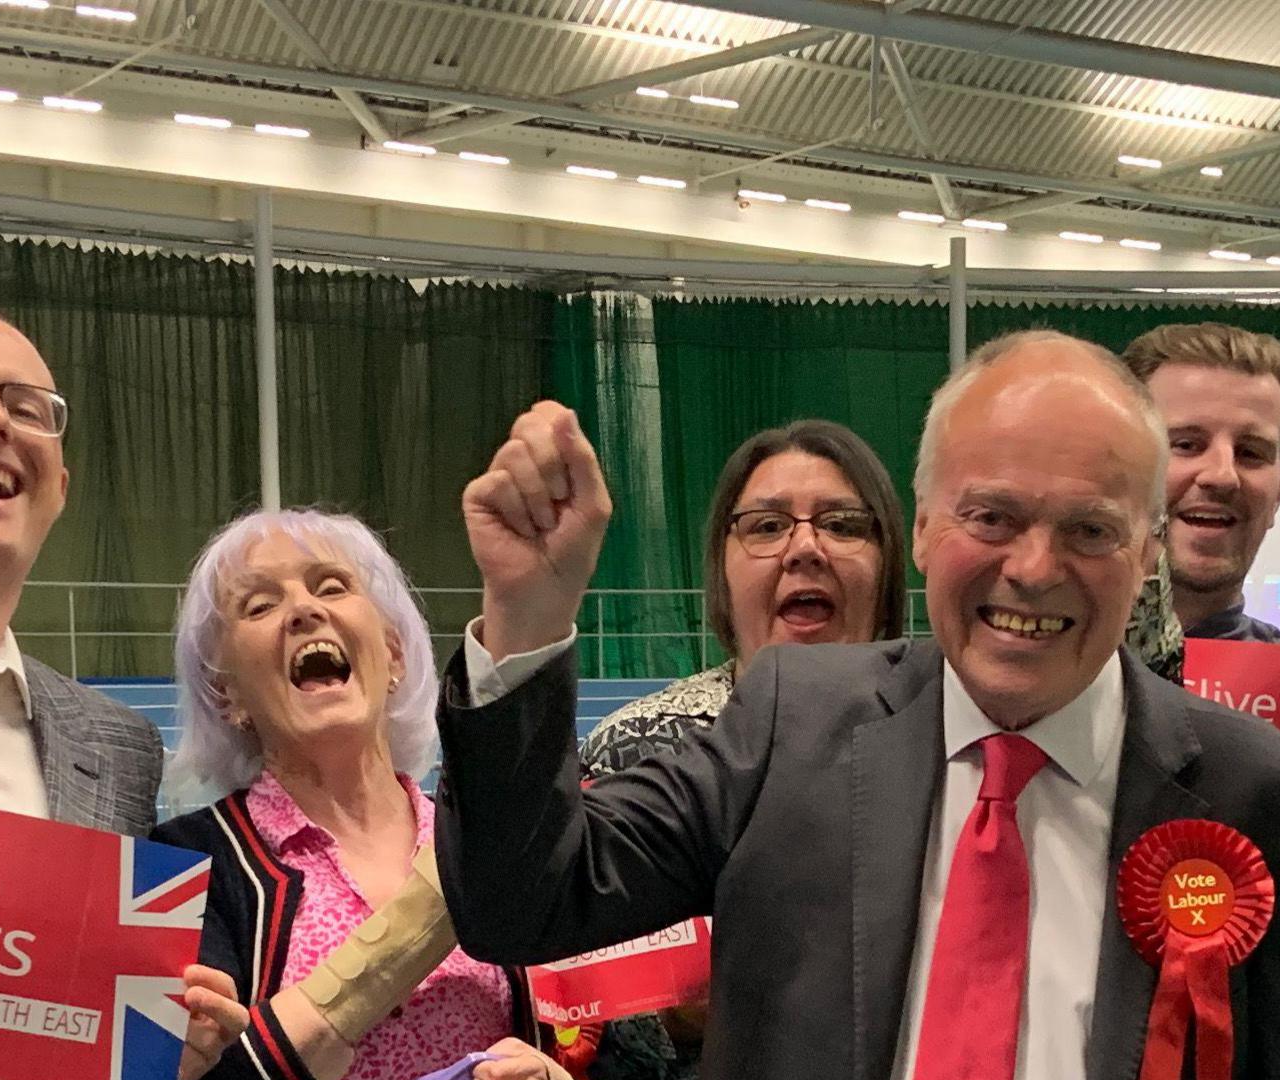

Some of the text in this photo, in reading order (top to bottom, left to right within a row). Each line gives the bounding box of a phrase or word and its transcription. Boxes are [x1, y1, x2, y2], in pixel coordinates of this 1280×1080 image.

[1184, 677, 1277, 722] live
[1174, 873, 1217, 889] Vote
[1167, 891, 1227, 910] Labour
[1190, 909, 1206, 926] X
[42, 1006, 99, 1038] EAST
